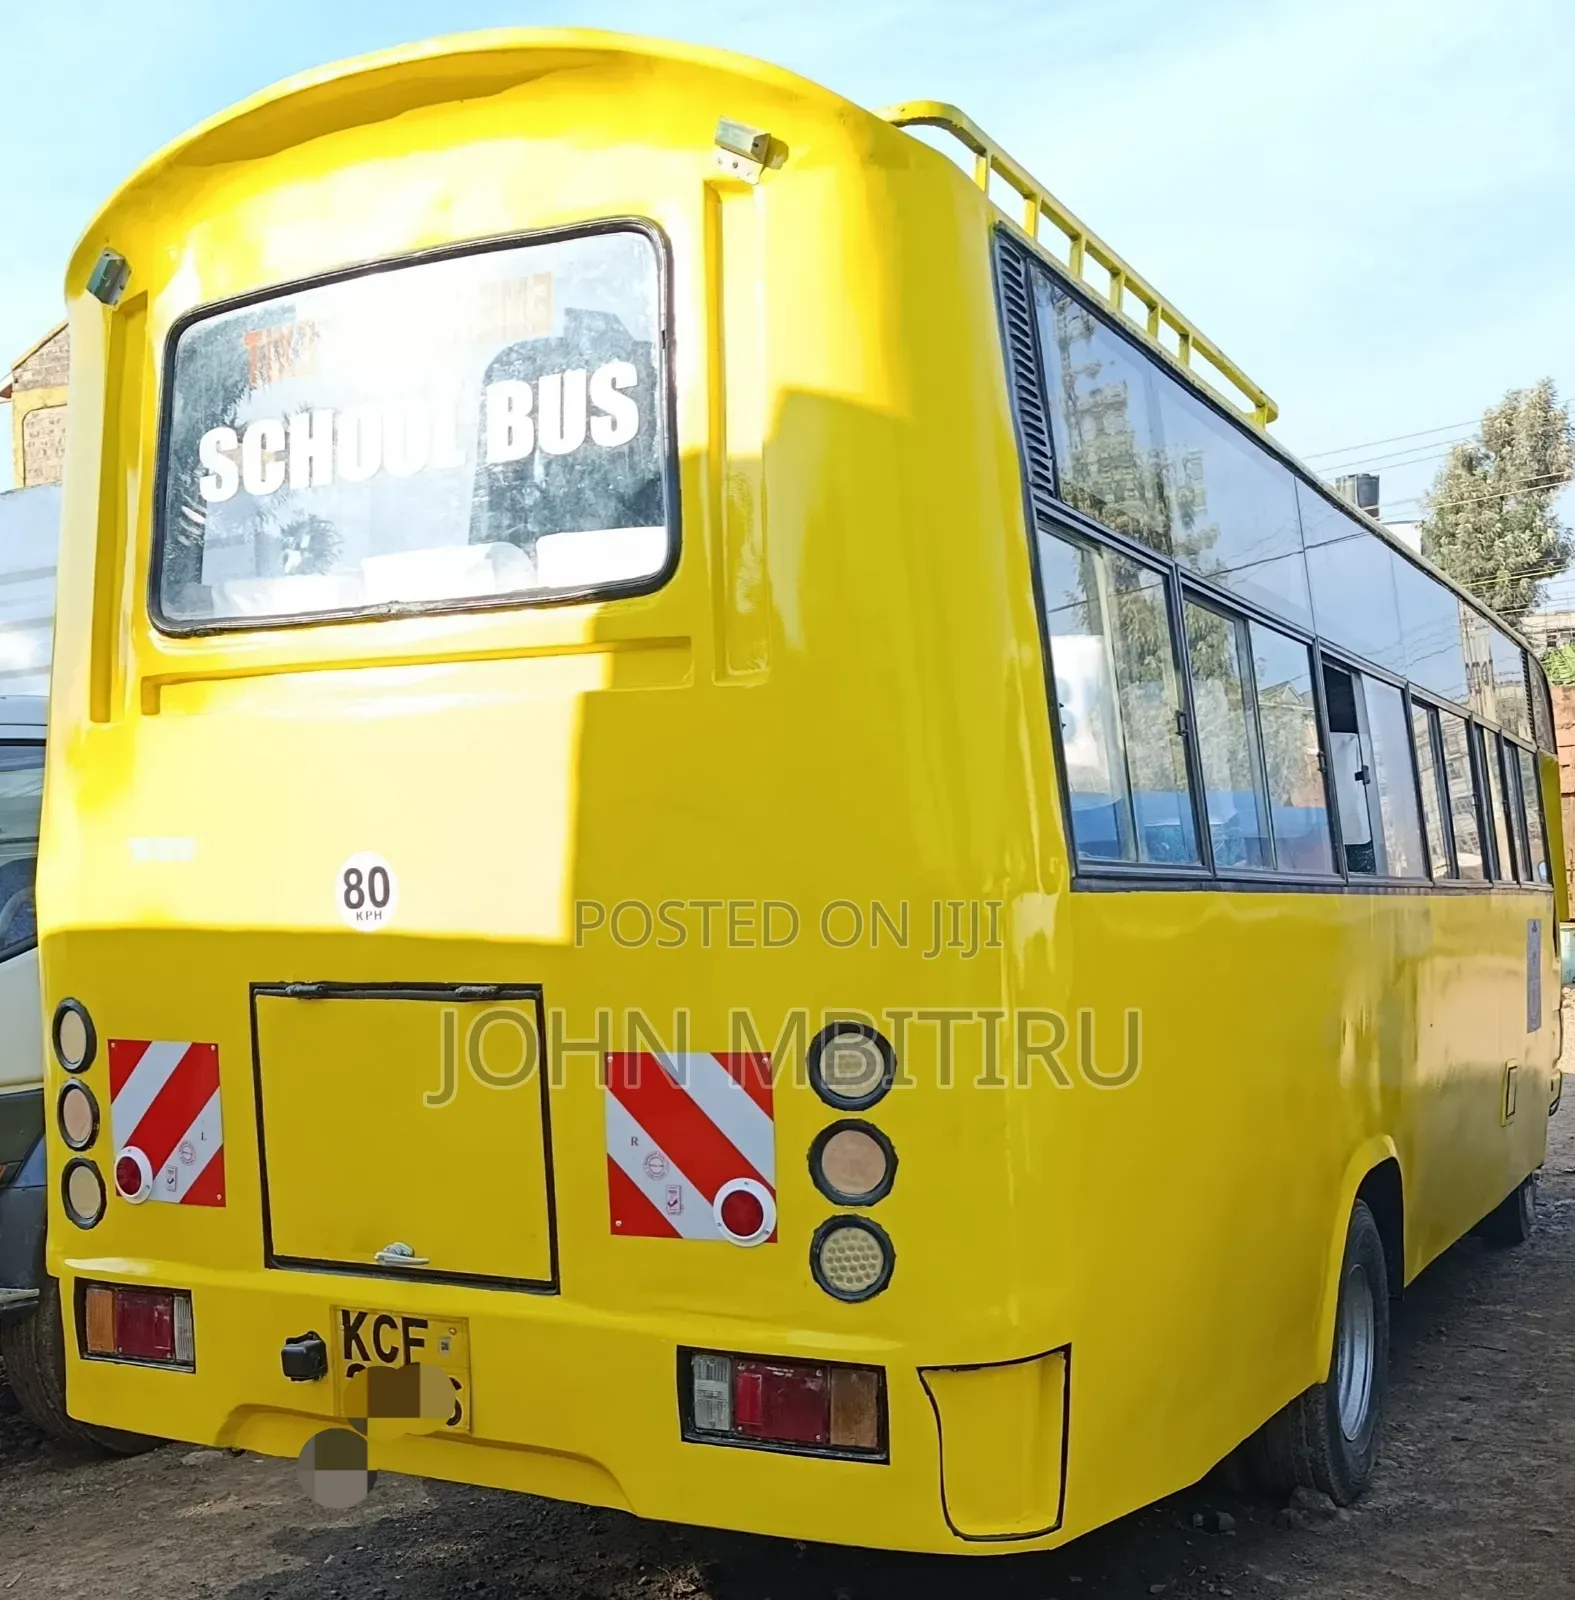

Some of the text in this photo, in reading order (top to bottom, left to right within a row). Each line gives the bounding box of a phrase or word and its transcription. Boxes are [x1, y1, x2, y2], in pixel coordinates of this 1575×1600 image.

[199, 360, 639, 503] SCHOOL BUS
[343, 865, 390, 909] 80
[356, 910, 382, 920] KPH
[630, 1136, 639, 1146] R
[341, 1309, 429, 1365] KCF
